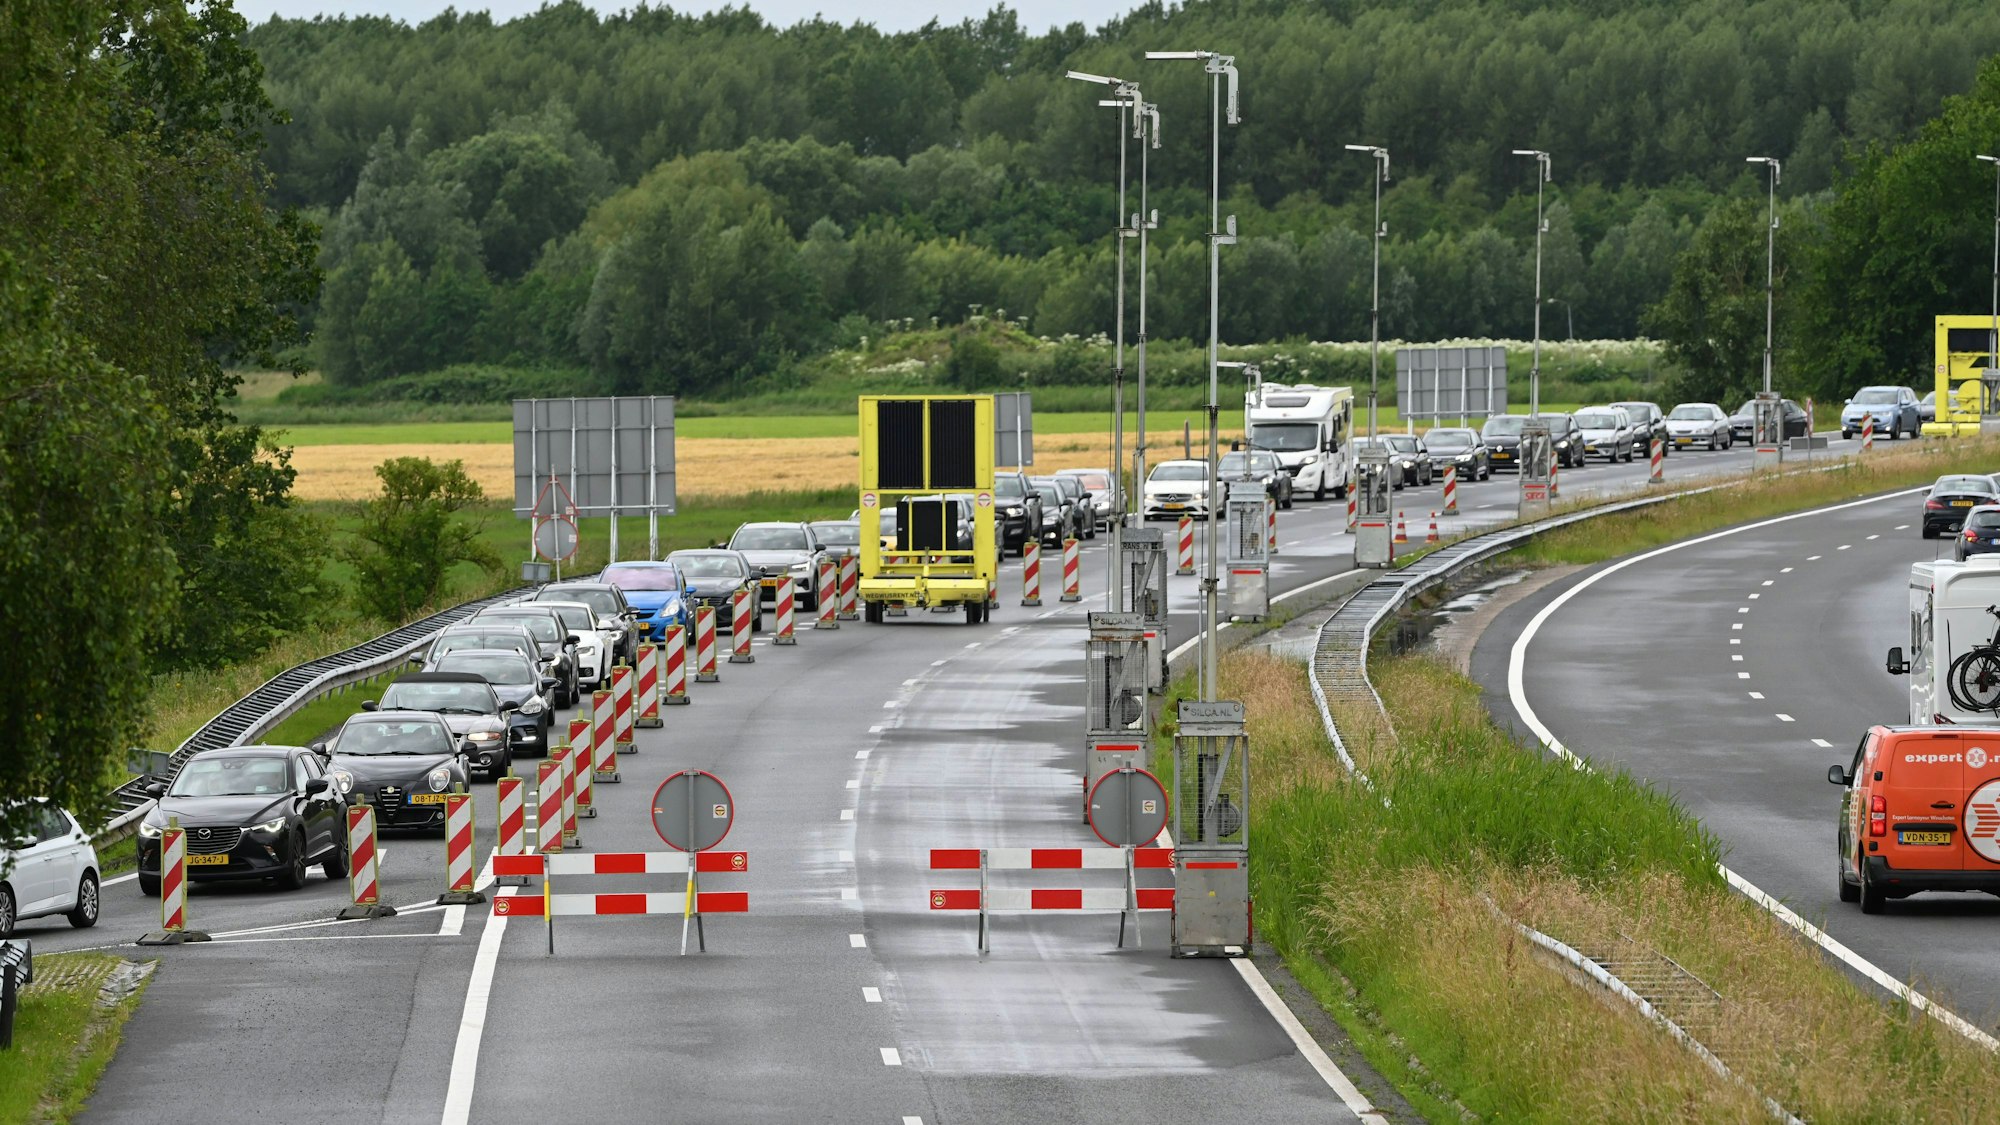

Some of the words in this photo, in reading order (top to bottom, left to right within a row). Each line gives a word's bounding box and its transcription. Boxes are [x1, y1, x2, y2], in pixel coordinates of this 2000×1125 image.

[1191, 707, 1233, 717] SILCA.NL
[1905, 753, 1963, 764] expert
[414, 795, 447, 803] 08-TJZ-9
[1906, 833, 1948, 842] VDN-35-T
[189, 855, 225, 865] JG-347-J
